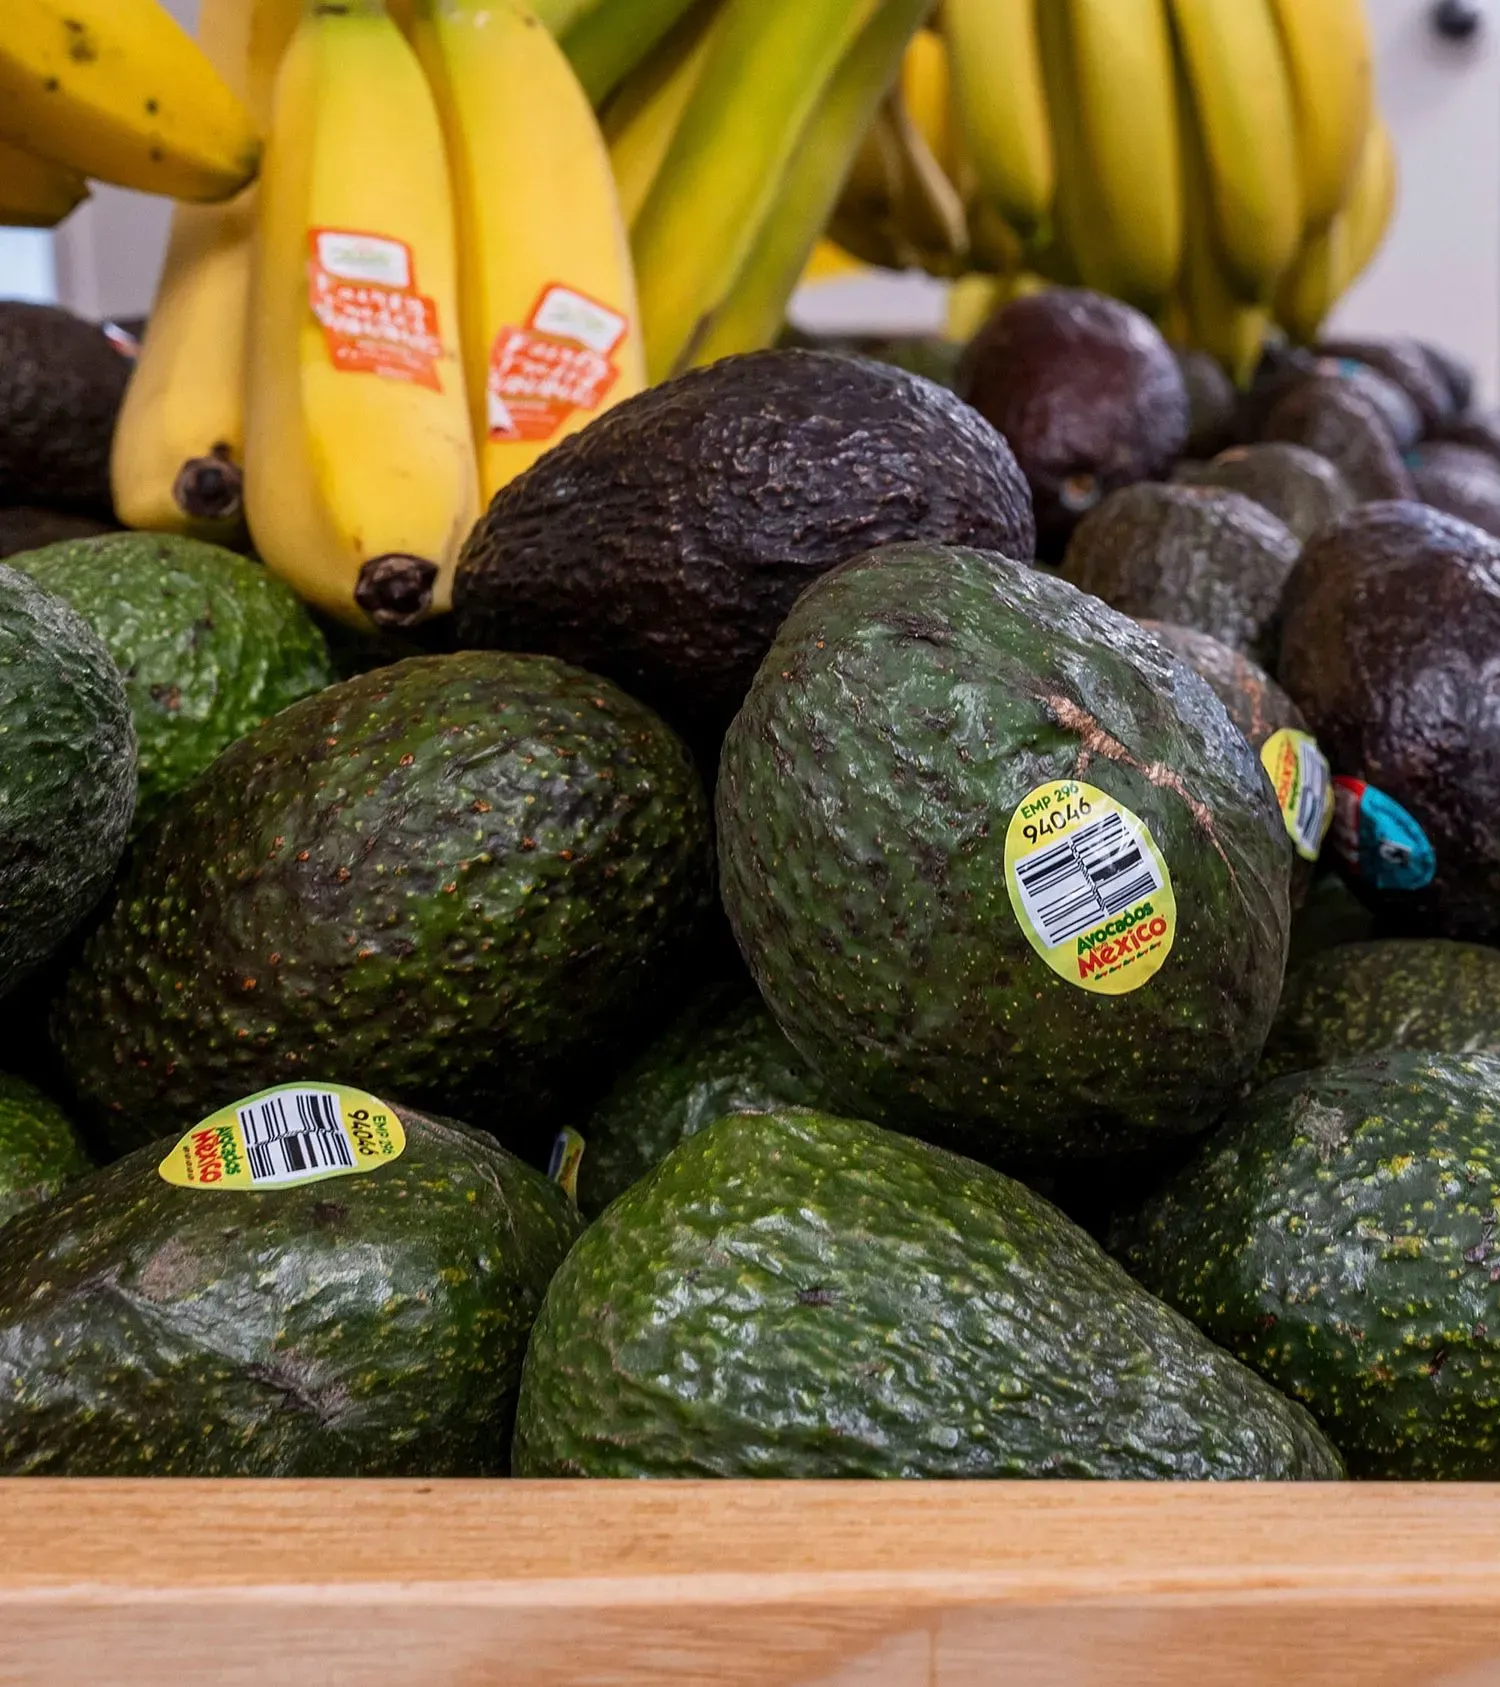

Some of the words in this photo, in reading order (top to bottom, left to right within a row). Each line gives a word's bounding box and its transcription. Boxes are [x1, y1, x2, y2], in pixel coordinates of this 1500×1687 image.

[1020, 796, 1052, 820] EMP
[1053, 783, 1080, 803] 296
[1022, 796, 1093, 845] 94046
[1076, 902, 1155, 956] Avocados
[1077, 917, 1168, 980] Mexico
[215, 1125, 244, 1176] Avocados
[347, 1109, 379, 1157] 94046
[372, 1115, 390, 1139] EMP
